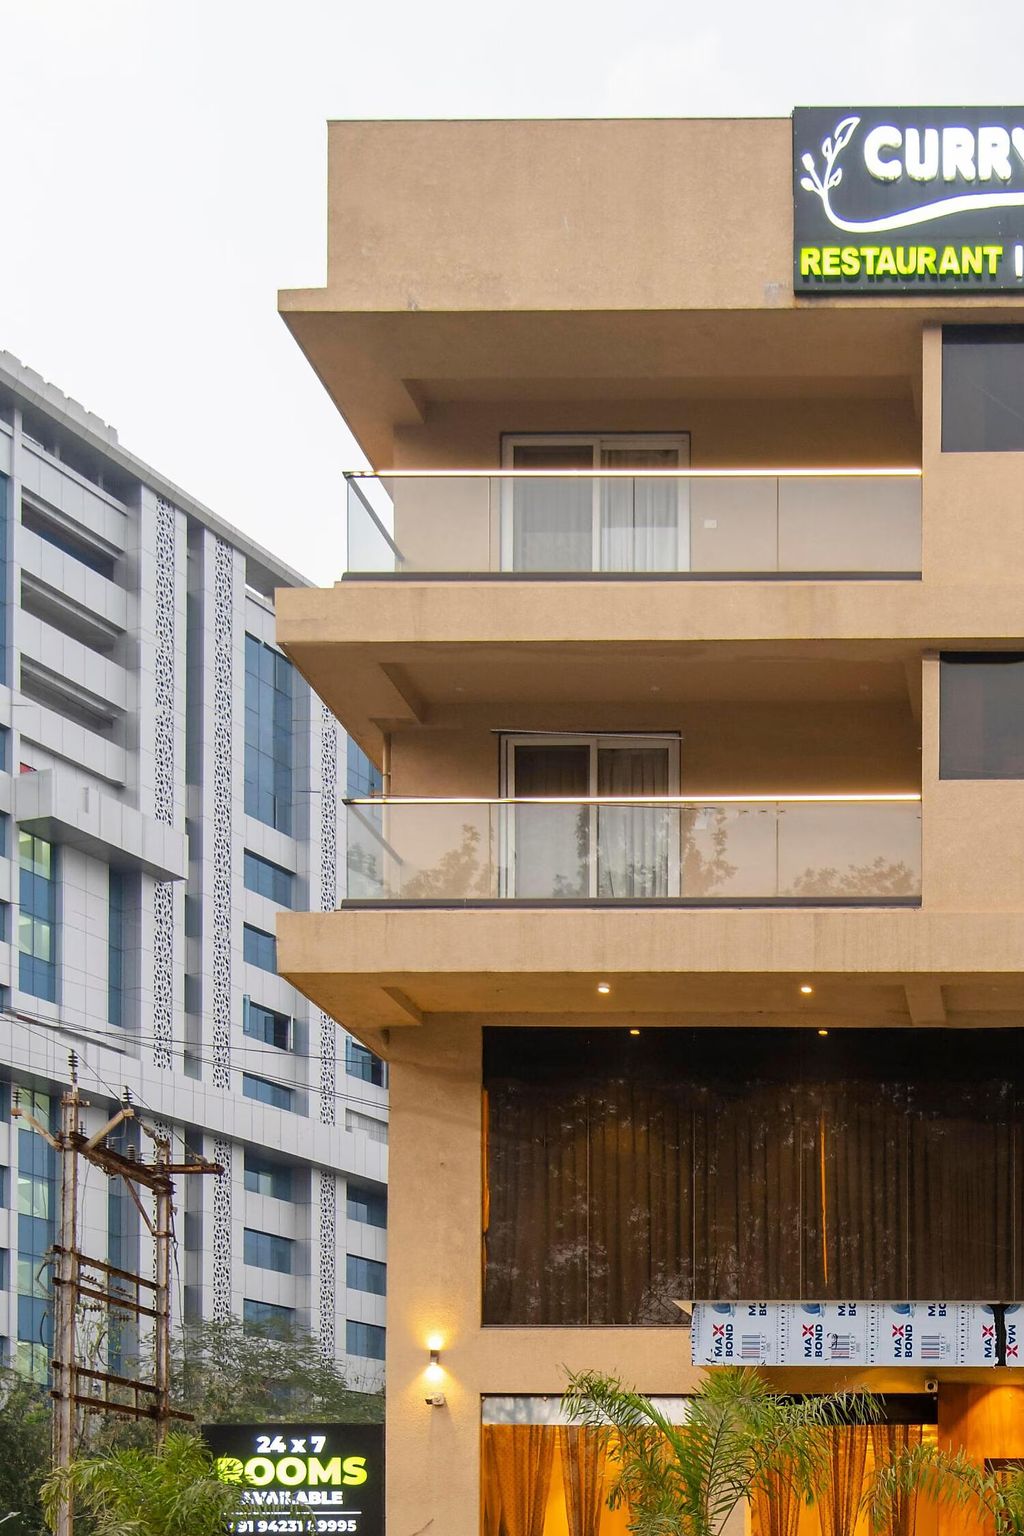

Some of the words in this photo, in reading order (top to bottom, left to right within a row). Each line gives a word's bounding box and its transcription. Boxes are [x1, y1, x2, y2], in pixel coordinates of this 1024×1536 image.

[800, 245, 1003, 276] RESTAURANT
[712, 1324, 725, 1357] MAX
[725, 1323, 734, 1357] BOND
[802, 1324, 814, 1357] MAX
[815, 1324, 823, 1357] BOND
[891, 1324, 904, 1357] MAX
[904, 1324, 913, 1357] BOND
[982, 1325, 994, 1358] MAX
[1006, 1325, 1018, 1358] MAX
[256, 1435, 286, 1453] 24
[310, 1436, 326, 1453] 7
[217, 1456, 368, 1486] ROOMS
[257, 1520, 304, 1532] 94231
